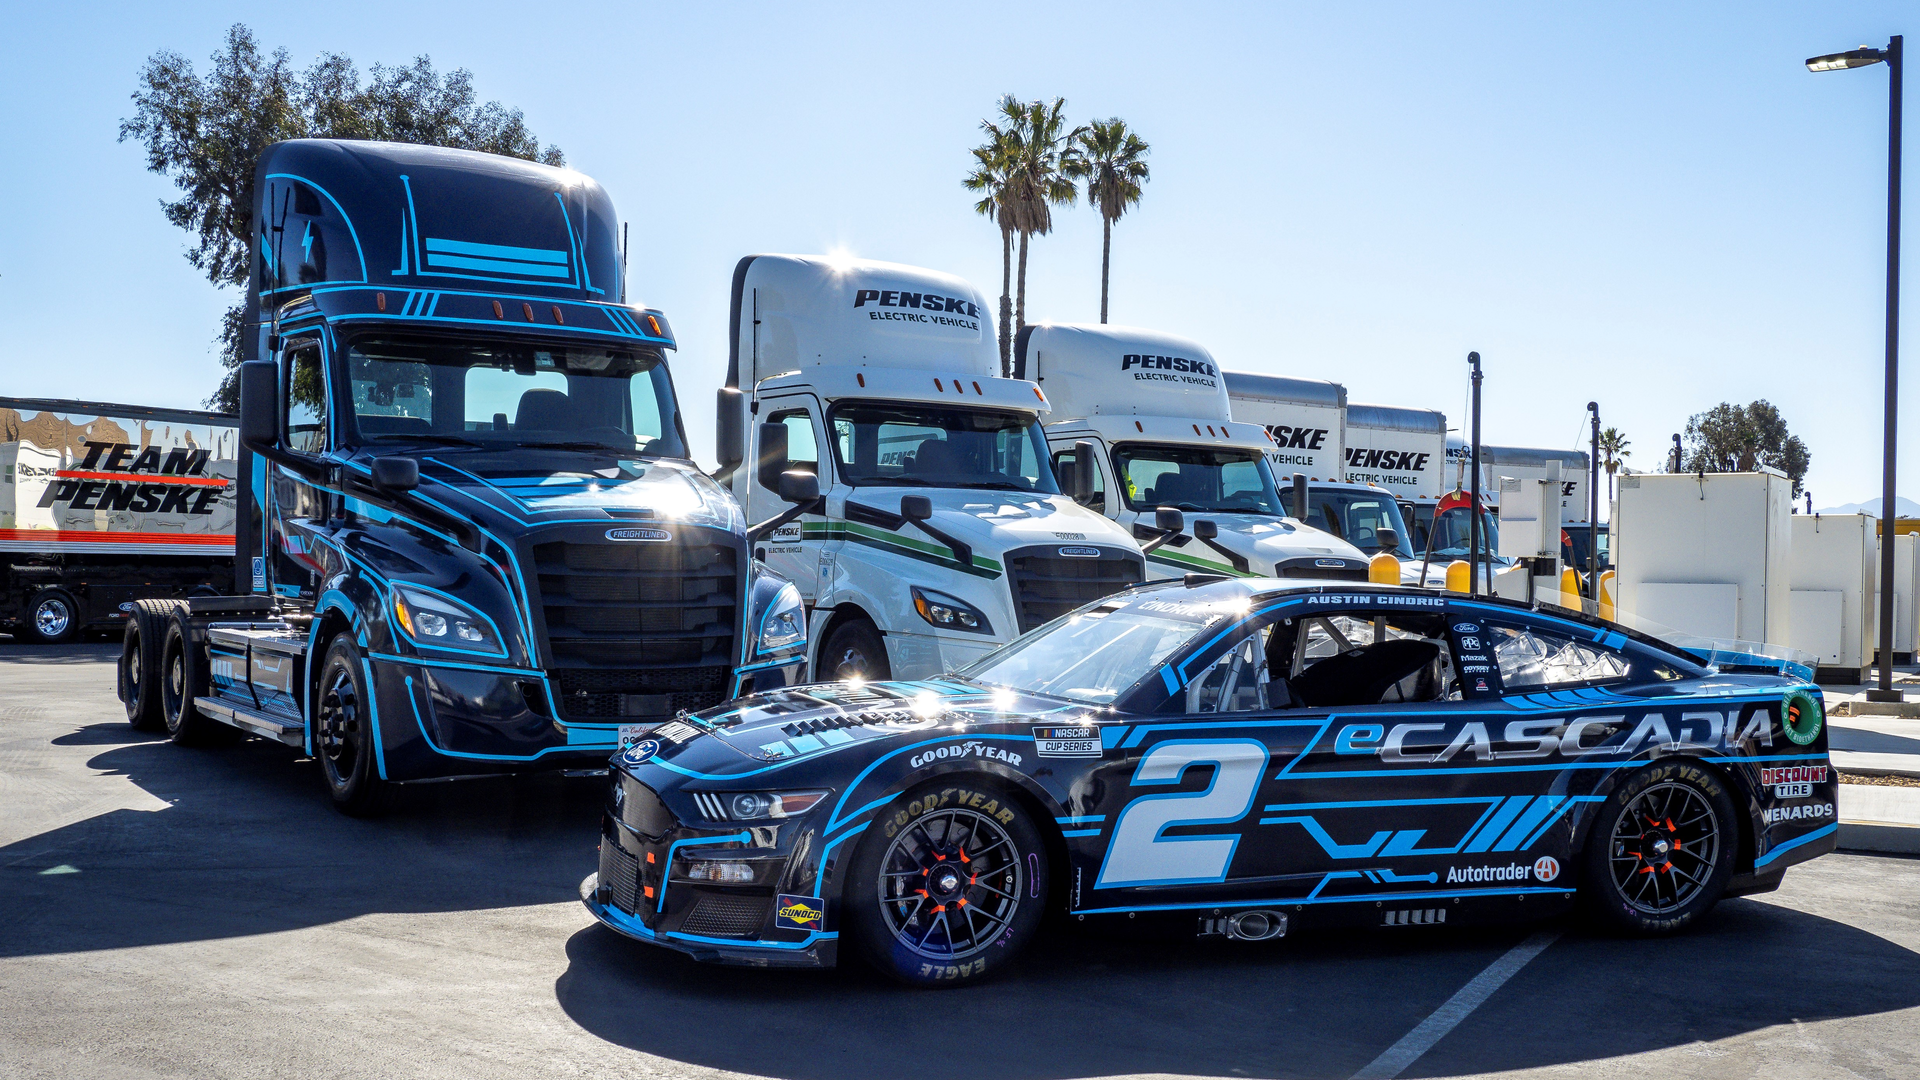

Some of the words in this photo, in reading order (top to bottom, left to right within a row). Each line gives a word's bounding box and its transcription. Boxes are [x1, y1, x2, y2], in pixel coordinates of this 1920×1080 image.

[853, 289, 981, 319] PENSKE
[869, 311, 928, 323] ELECTRIC
[930, 315, 979, 331] VEHICLE
[1121, 354, 1217, 378] PENSKE
[1133, 373, 1179, 383] ELECTRIC
[1180, 375, 1217, 388] VEHICLE
[1260, 424, 1329, 450] SKE
[80, 440, 212, 476] TEAM
[1272, 453, 1314, 466] VEHICLE
[1345, 472, 1380, 484] LECTRIC
[1382, 474, 1418, 485] VEHICLE
[36, 480, 224, 515] PENSKE
[613, 530, 666, 538] FREIGHTLINER
[773, 527, 800, 536] PENSKE
[1063, 547, 1097, 555] FREIGHTLINER
[1307, 595, 1371, 604] AUSTIN
[1377, 596, 1445, 606] CINDRIC
[1055, 729, 1090, 737] NASCAR
[1334, 708, 1774, 763] eCASCADIA
[1045, 742, 1062, 751] CUP
[1063, 741, 1093, 751] SERIES
[1762, 765, 1828, 786] DISCOUNT
[1778, 784, 1809, 796] TIRE
[1093, 737, 1271, 890] 2
[1764, 803, 1834, 822] MENARDS
[1446, 862, 1532, 883] Autotrader
[780, 908, 821, 920] SUNOCO
[918, 956, 987, 980] EAGLE
